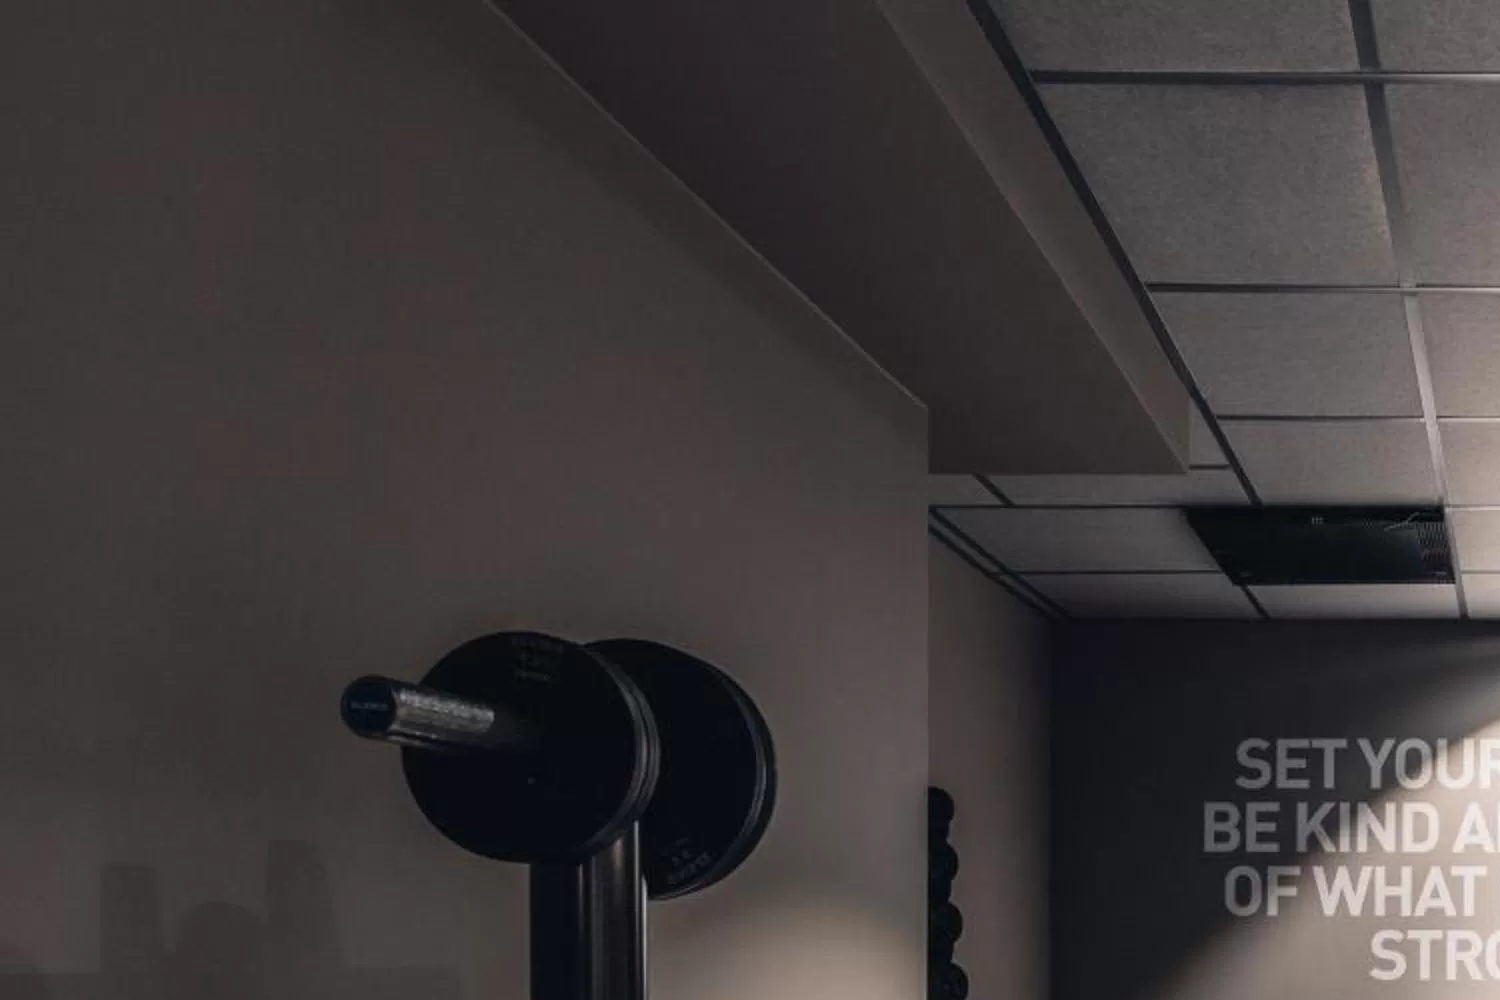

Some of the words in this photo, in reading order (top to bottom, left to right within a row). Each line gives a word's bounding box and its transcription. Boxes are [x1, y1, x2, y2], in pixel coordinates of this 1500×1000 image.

[1235, 738, 1348, 790] SET
[1204, 802, 1281, 853] BE
[1296, 802, 1439, 853] KIND
[1225, 866, 1301, 917] OF
[1312, 866, 1488, 917] WHAT
